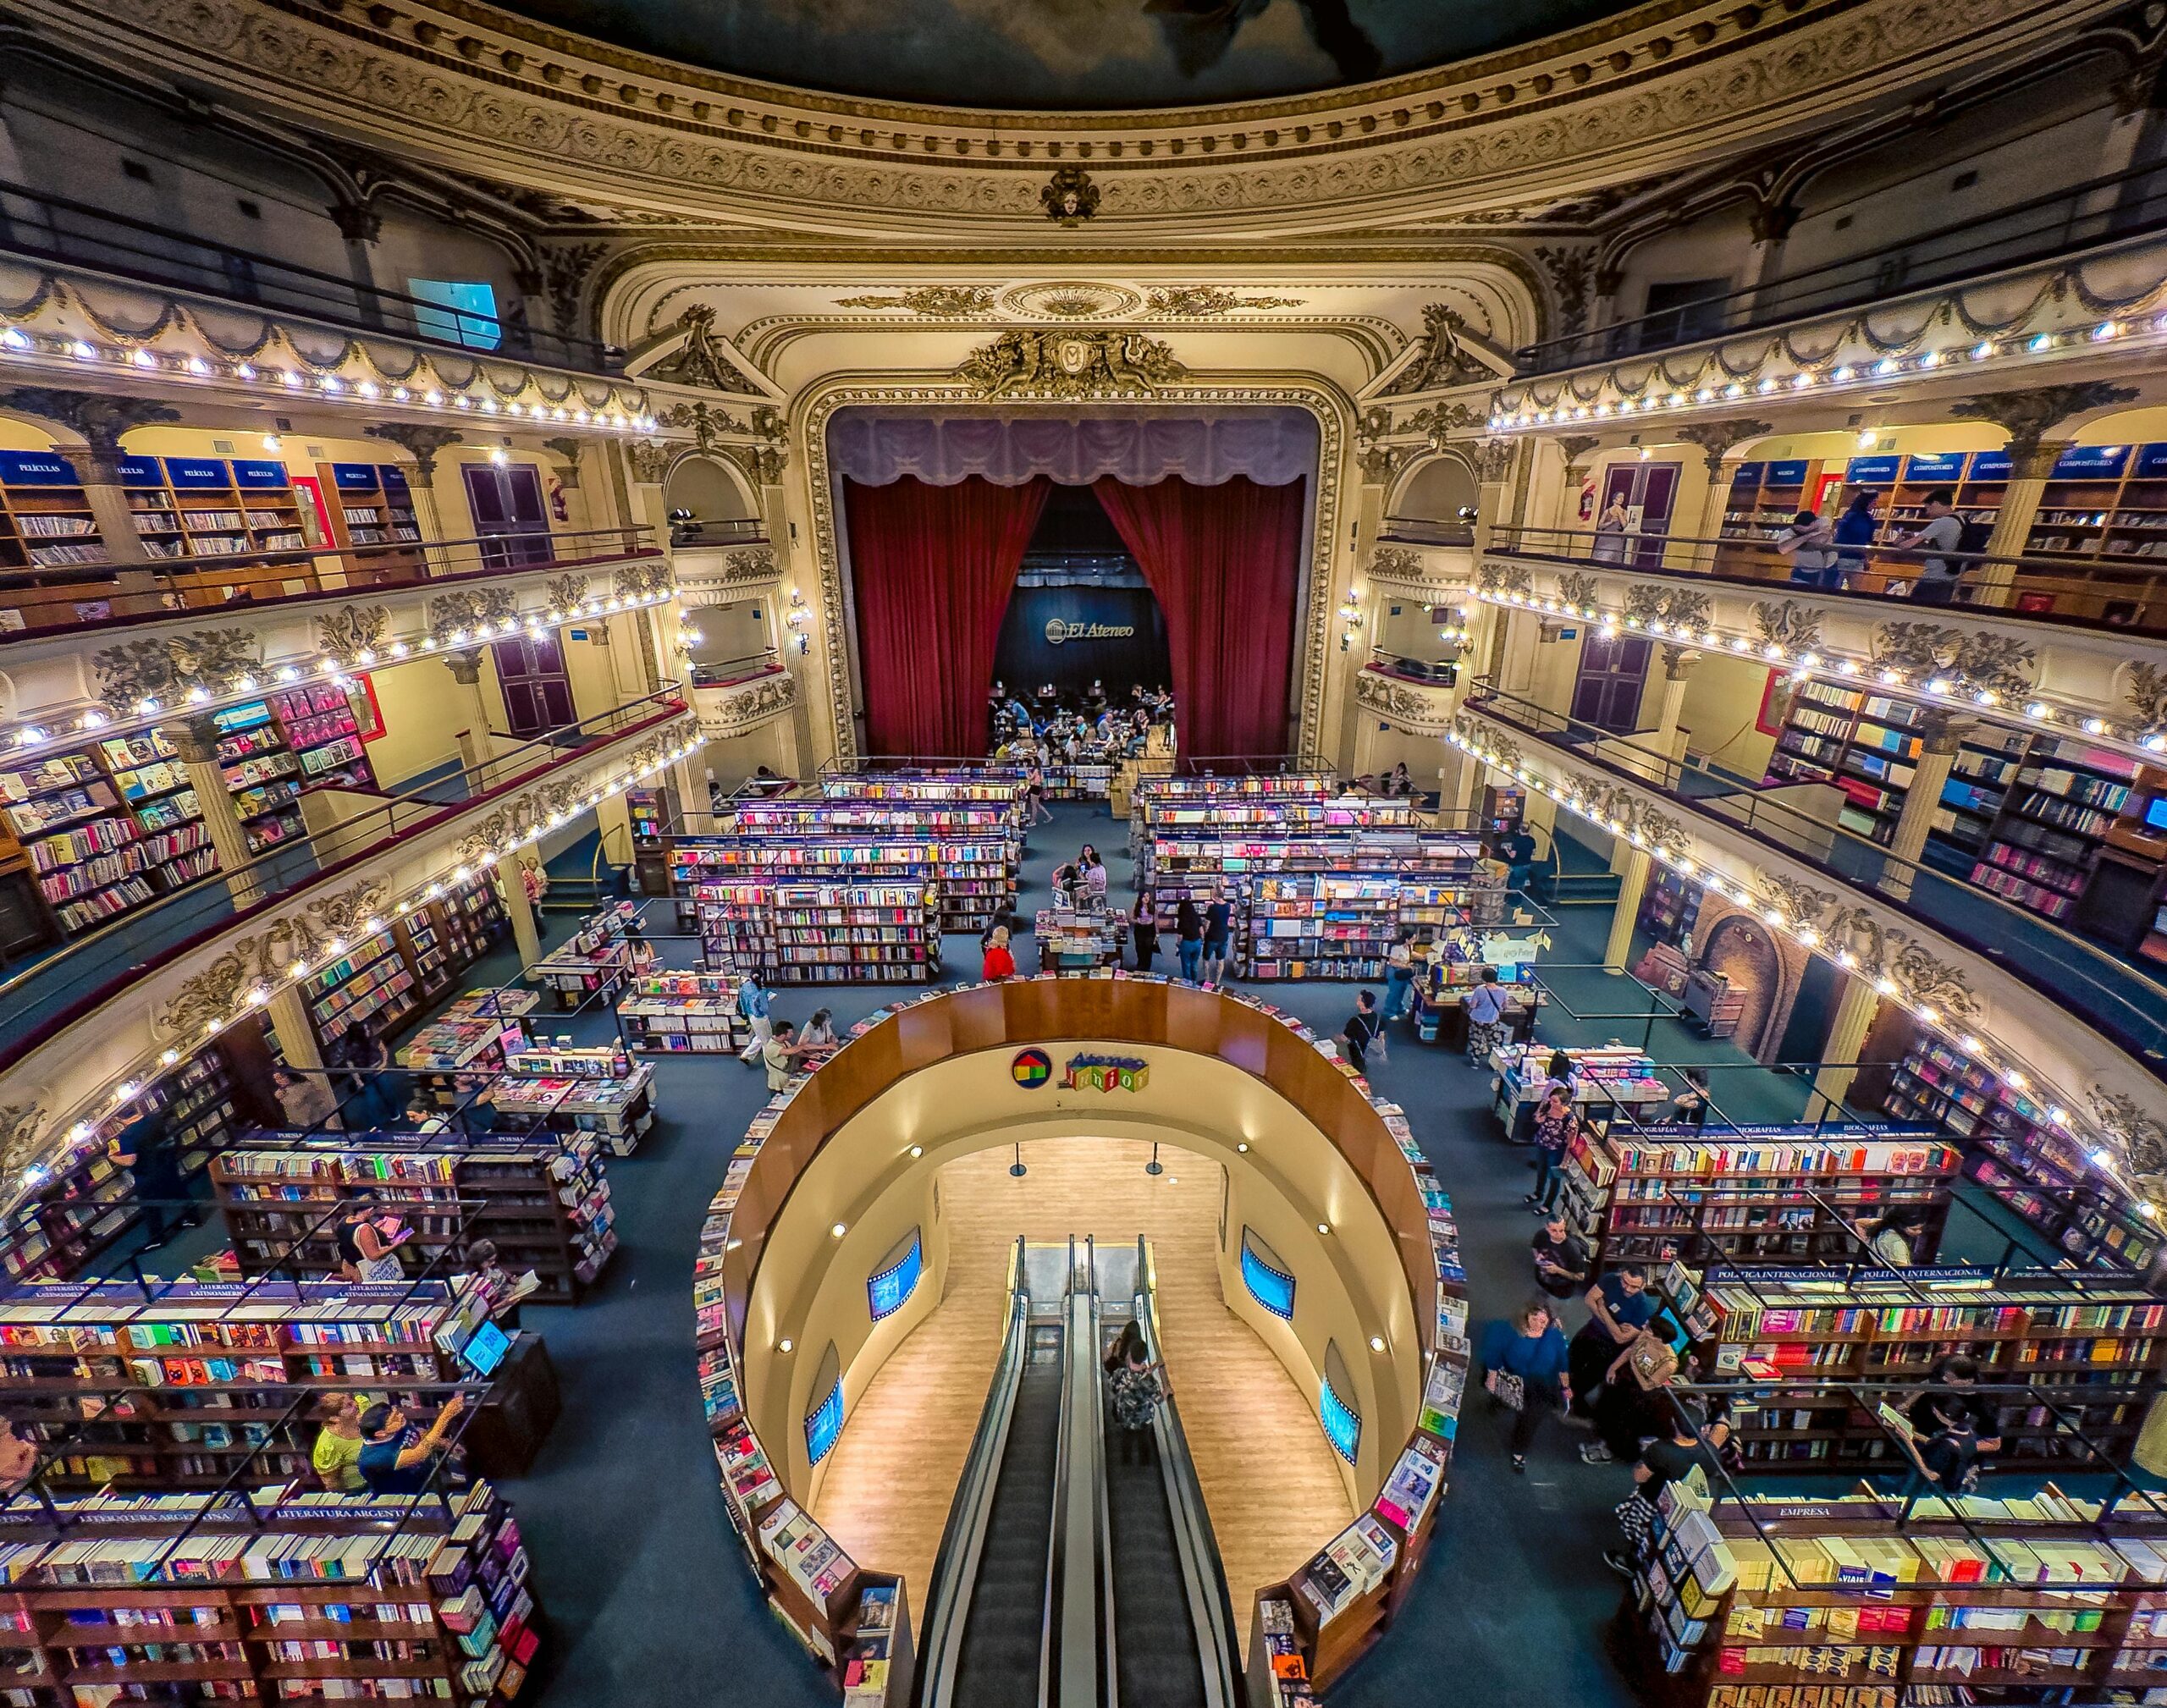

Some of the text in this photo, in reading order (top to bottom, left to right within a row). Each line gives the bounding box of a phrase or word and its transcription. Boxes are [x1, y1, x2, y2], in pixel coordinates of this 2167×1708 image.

[1067, 622, 1134, 638] El Ateneo
[1068, 1069, 1145, 1088] Junior
[1908, 1269, 1983, 1277] INTERNACIONAL
[1779, 1507, 1830, 1516] EMPRESA
[80, 1514, 157, 1523] LITERATURA
